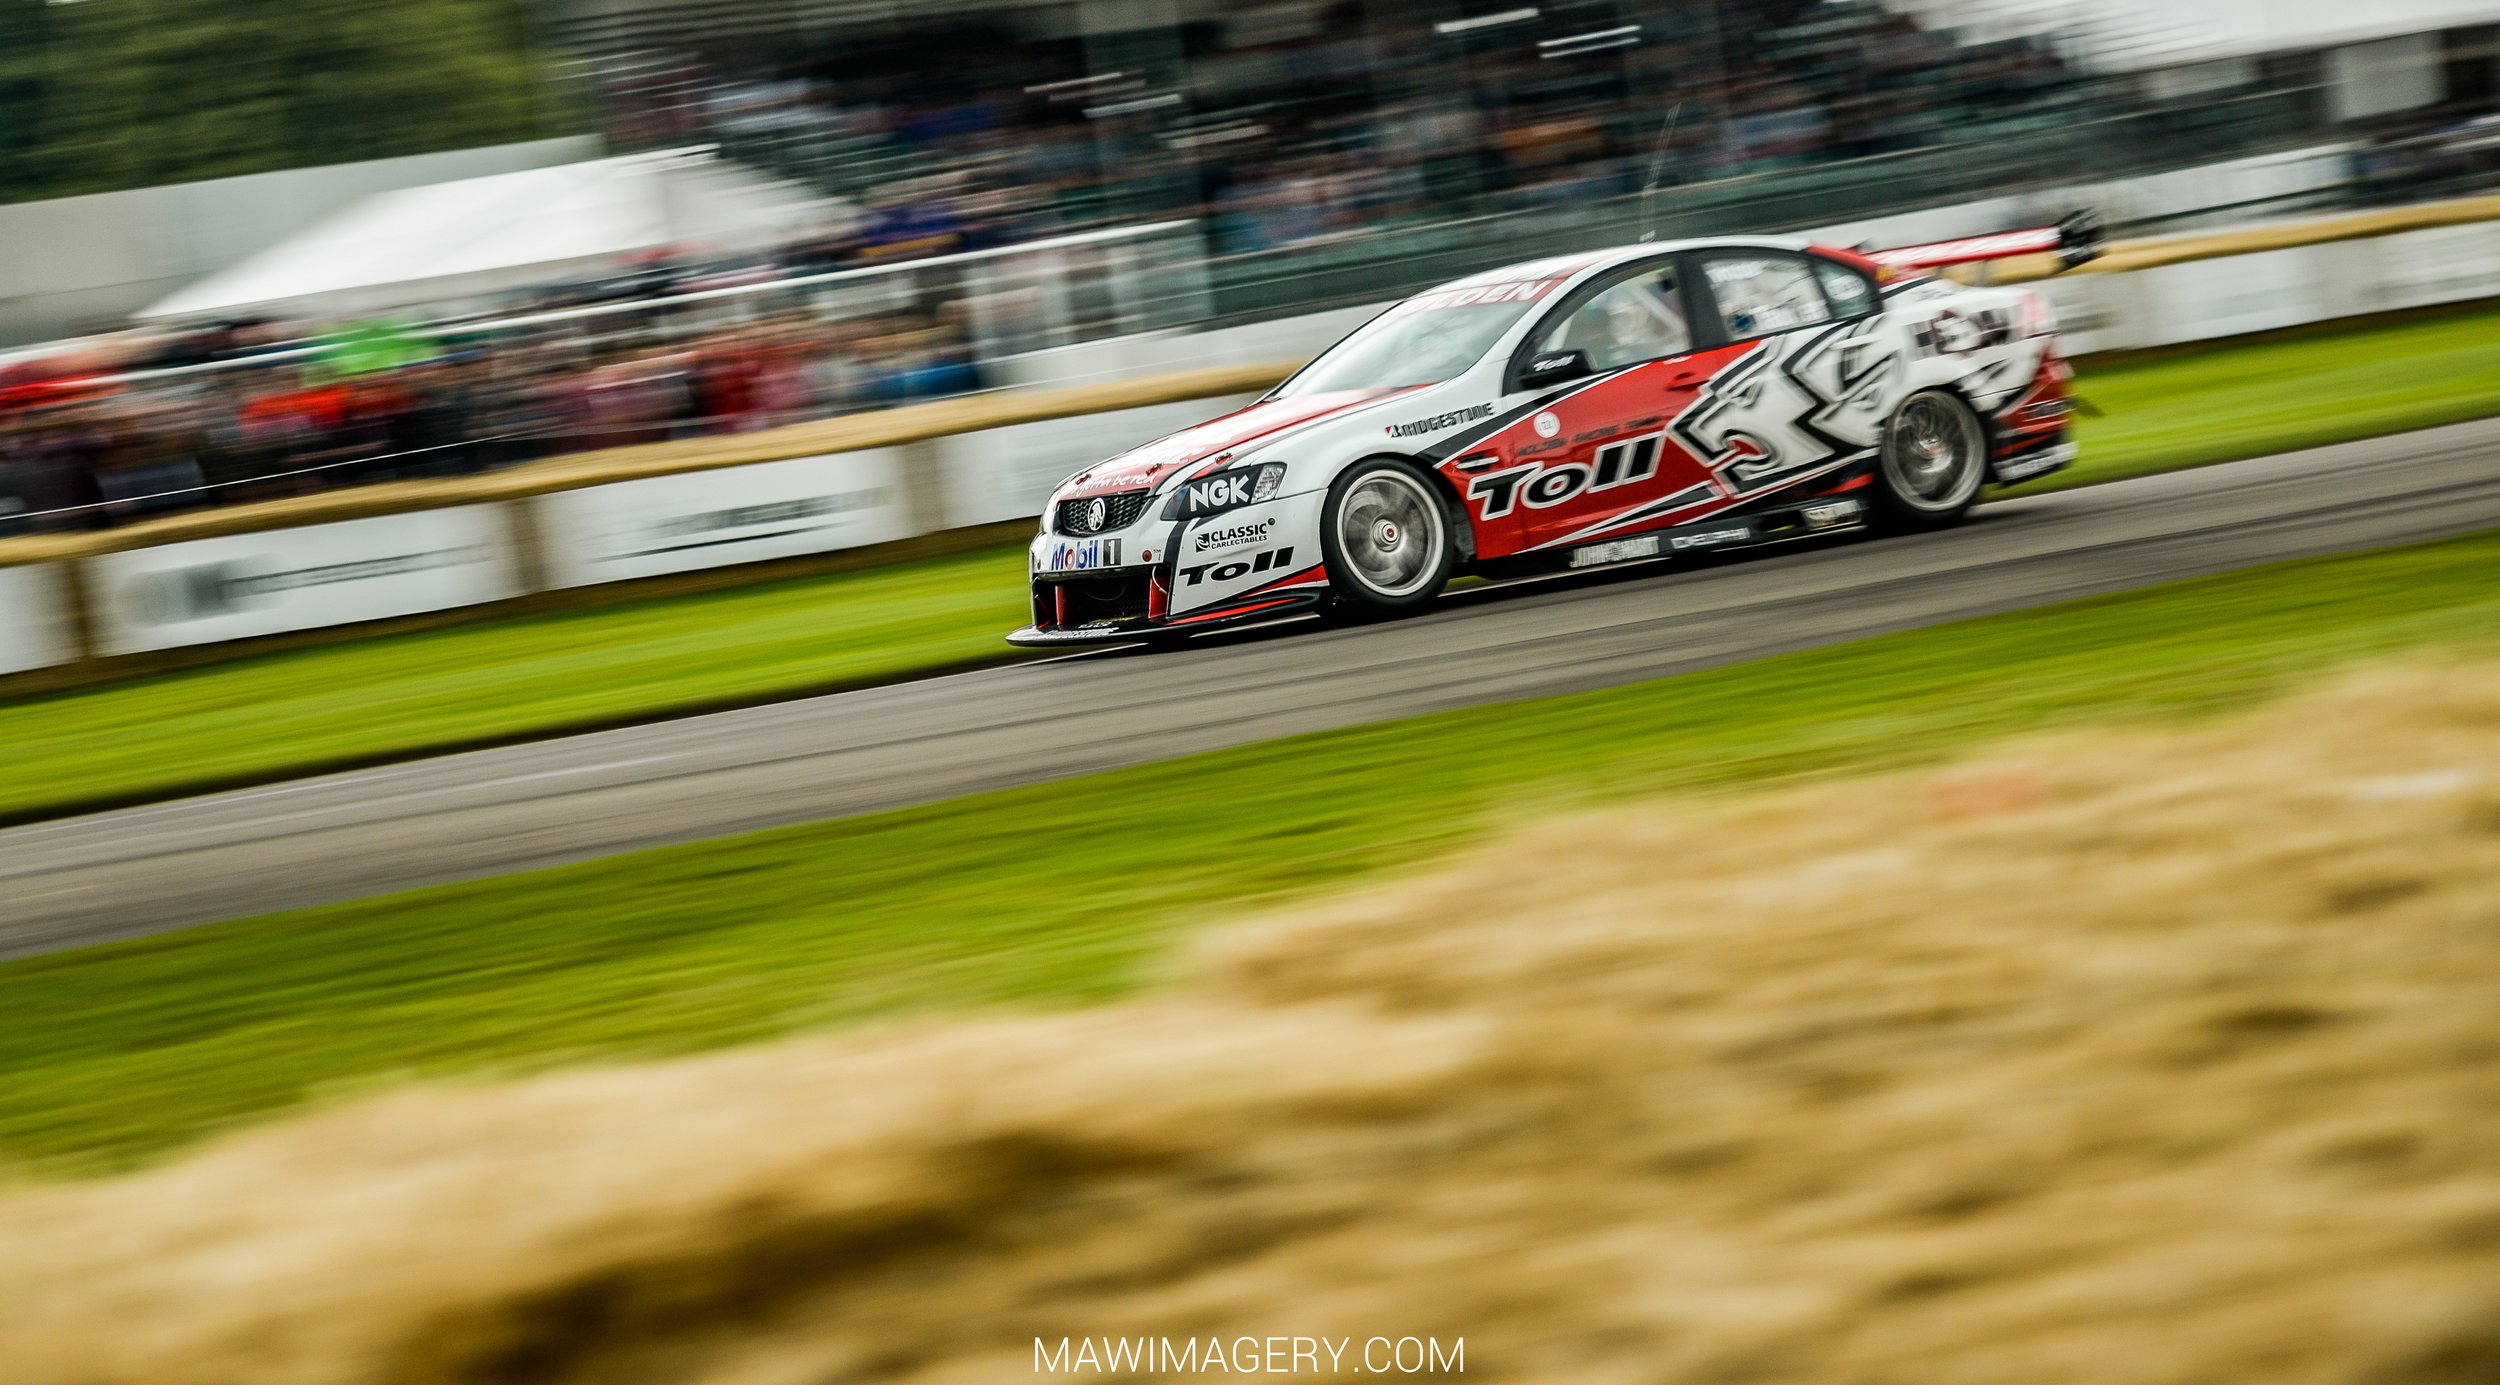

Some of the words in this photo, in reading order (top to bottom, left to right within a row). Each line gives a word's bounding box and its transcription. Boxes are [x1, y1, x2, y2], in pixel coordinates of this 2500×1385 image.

[1385, 402, 1494, 438] BRIDGESTONE
[1189, 474, 1250, 513] NGK
[1466, 430, 1667, 521] Toll
[1211, 523, 1267, 542] CLASSIC
[1211, 535, 1268, 549] CARLECTABLES
[1051, 538, 1099, 571] Mobil
[1179, 546, 1295, 586] Toll
